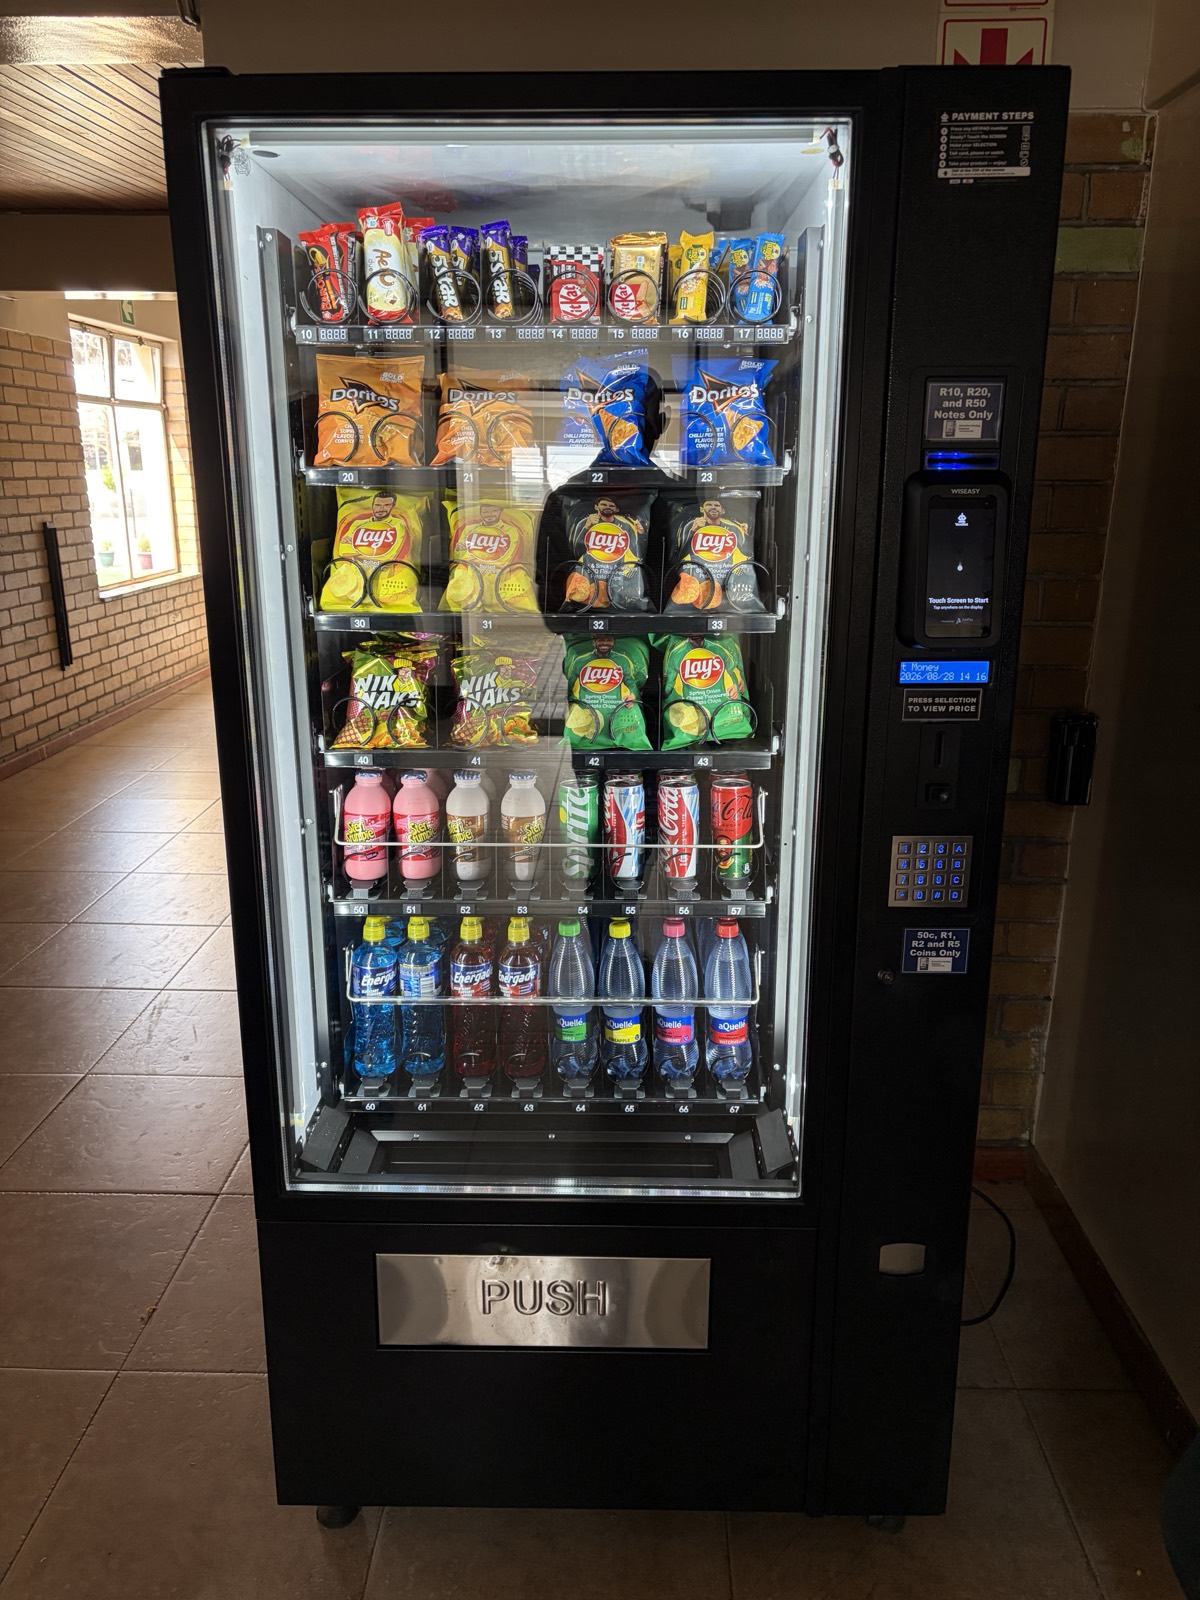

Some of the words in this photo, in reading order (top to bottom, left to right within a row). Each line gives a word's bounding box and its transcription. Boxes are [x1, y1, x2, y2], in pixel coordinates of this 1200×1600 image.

[952, 112, 999, 120] PAYMENT
[1002, 112, 1034, 120] STEPS
[373, 248, 398, 287] Aeo
[301, 330, 312, 340] 10
[368, 330, 378, 340] 11
[429, 330, 440, 340] 12
[490, 330, 502, 340] 13
[551, 329, 563, 339] 14
[612, 329, 624, 339] 15
[677, 329, 689, 339] 16
[739, 329, 750, 339] 17
[449, 389, 516, 404] Doritos
[568, 387, 634, 404] Doritos
[690, 384, 759, 403] Doritos
[940, 388, 964, 398] R10,
[967, 388, 991, 398] R20,
[332, 388, 398, 411] Doritos
[942, 400, 962, 408] and
[965, 399, 986, 407] R50
[934, 410, 965, 419] Notes
[968, 410, 993, 420] Only
[342, 473, 353, 482] 20
[464, 473, 473, 482] 21
[592, 473, 603, 482] 22
[701, 473, 712, 482] 23
[356, 528, 394, 547] Lay's
[471, 534, 508, 553] Lay's
[588, 532, 626, 553] Lay's
[695, 532, 734, 553] Lay's
[354, 620, 365, 628] 30
[482, 620, 492, 628] 31
[593, 621, 604, 629] 32
[712, 621, 723, 629] 33
[685, 657, 722, 680] Lay's
[911, 663, 940, 671] Money
[583, 666, 621, 684] Lay's
[900, 672, 954, 680] 2026/08/28
[960, 672, 970, 680] 14
[976, 672, 987, 680] 16
[354, 674, 398, 693] NIK
[460, 672, 498, 692] NIK
[360, 690, 419, 710] NAKS
[465, 688, 521, 711] NAKS
[358, 756, 369, 764] 40
[471, 757, 481, 765] 41
[589, 758, 600, 766] 42
[698, 757, 708, 765] 43
[560, 785, 594, 878] Sprite
[920, 845, 926, 853] 2
[938, 845, 944, 853] 3
[956, 845, 963, 853] A
[901, 860, 907, 869] 4
[918, 860, 925, 869] 5
[936, 860, 943, 869] 6
[900, 876, 906, 884] 7
[917, 876, 924, 884] 8
[935, 876, 942, 884] 9
[953, 876, 960, 884] C
[916, 891, 923, 900] 0
[354, 906, 364, 914] 50
[406, 906, 416, 914] 51
[460, 906, 470, 914] 52
[517, 906, 528, 914] 53
[578, 907, 588, 915] 54
[625, 907, 636, 915] 55
[679, 907, 689, 915] 56
[731, 907, 742, 915] 57
[917, 931, 938, 940] 50c,
[940, 931, 956, 940] R1,
[912, 940, 925, 948] R2
[927, 940, 945, 948] and
[947, 940, 960, 948] R5
[910, 949, 937, 957] Coins
[939, 949, 961, 958] Only
[366, 1103, 375, 1111] 60
[418, 1103, 426, 1111] 61
[524, 1104, 534, 1112] 63
[481, 1279, 607, 1316] PUSH
